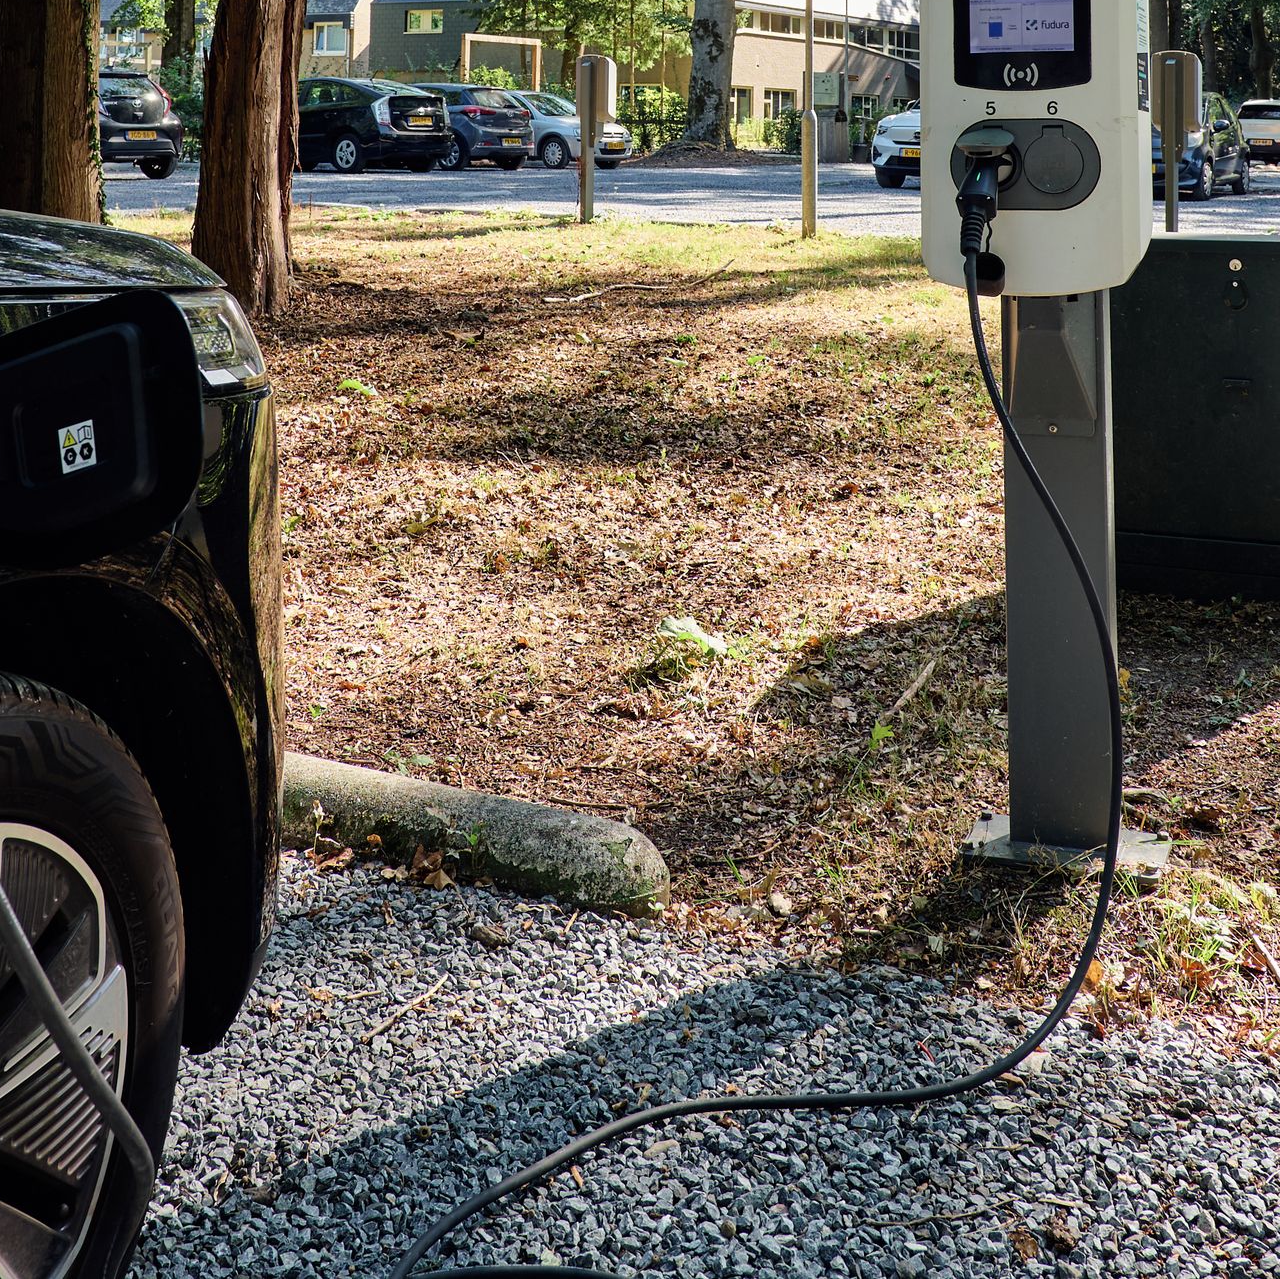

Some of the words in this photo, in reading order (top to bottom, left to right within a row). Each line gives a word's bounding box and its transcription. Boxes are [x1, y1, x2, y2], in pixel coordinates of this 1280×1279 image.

[1041, 20, 1070, 29] fudura
[985, 101, 996, 115] 5
[1047, 100, 1058, 115] 6
[67, 452, 73, 461] C
[83, 447, 89, 456] K
